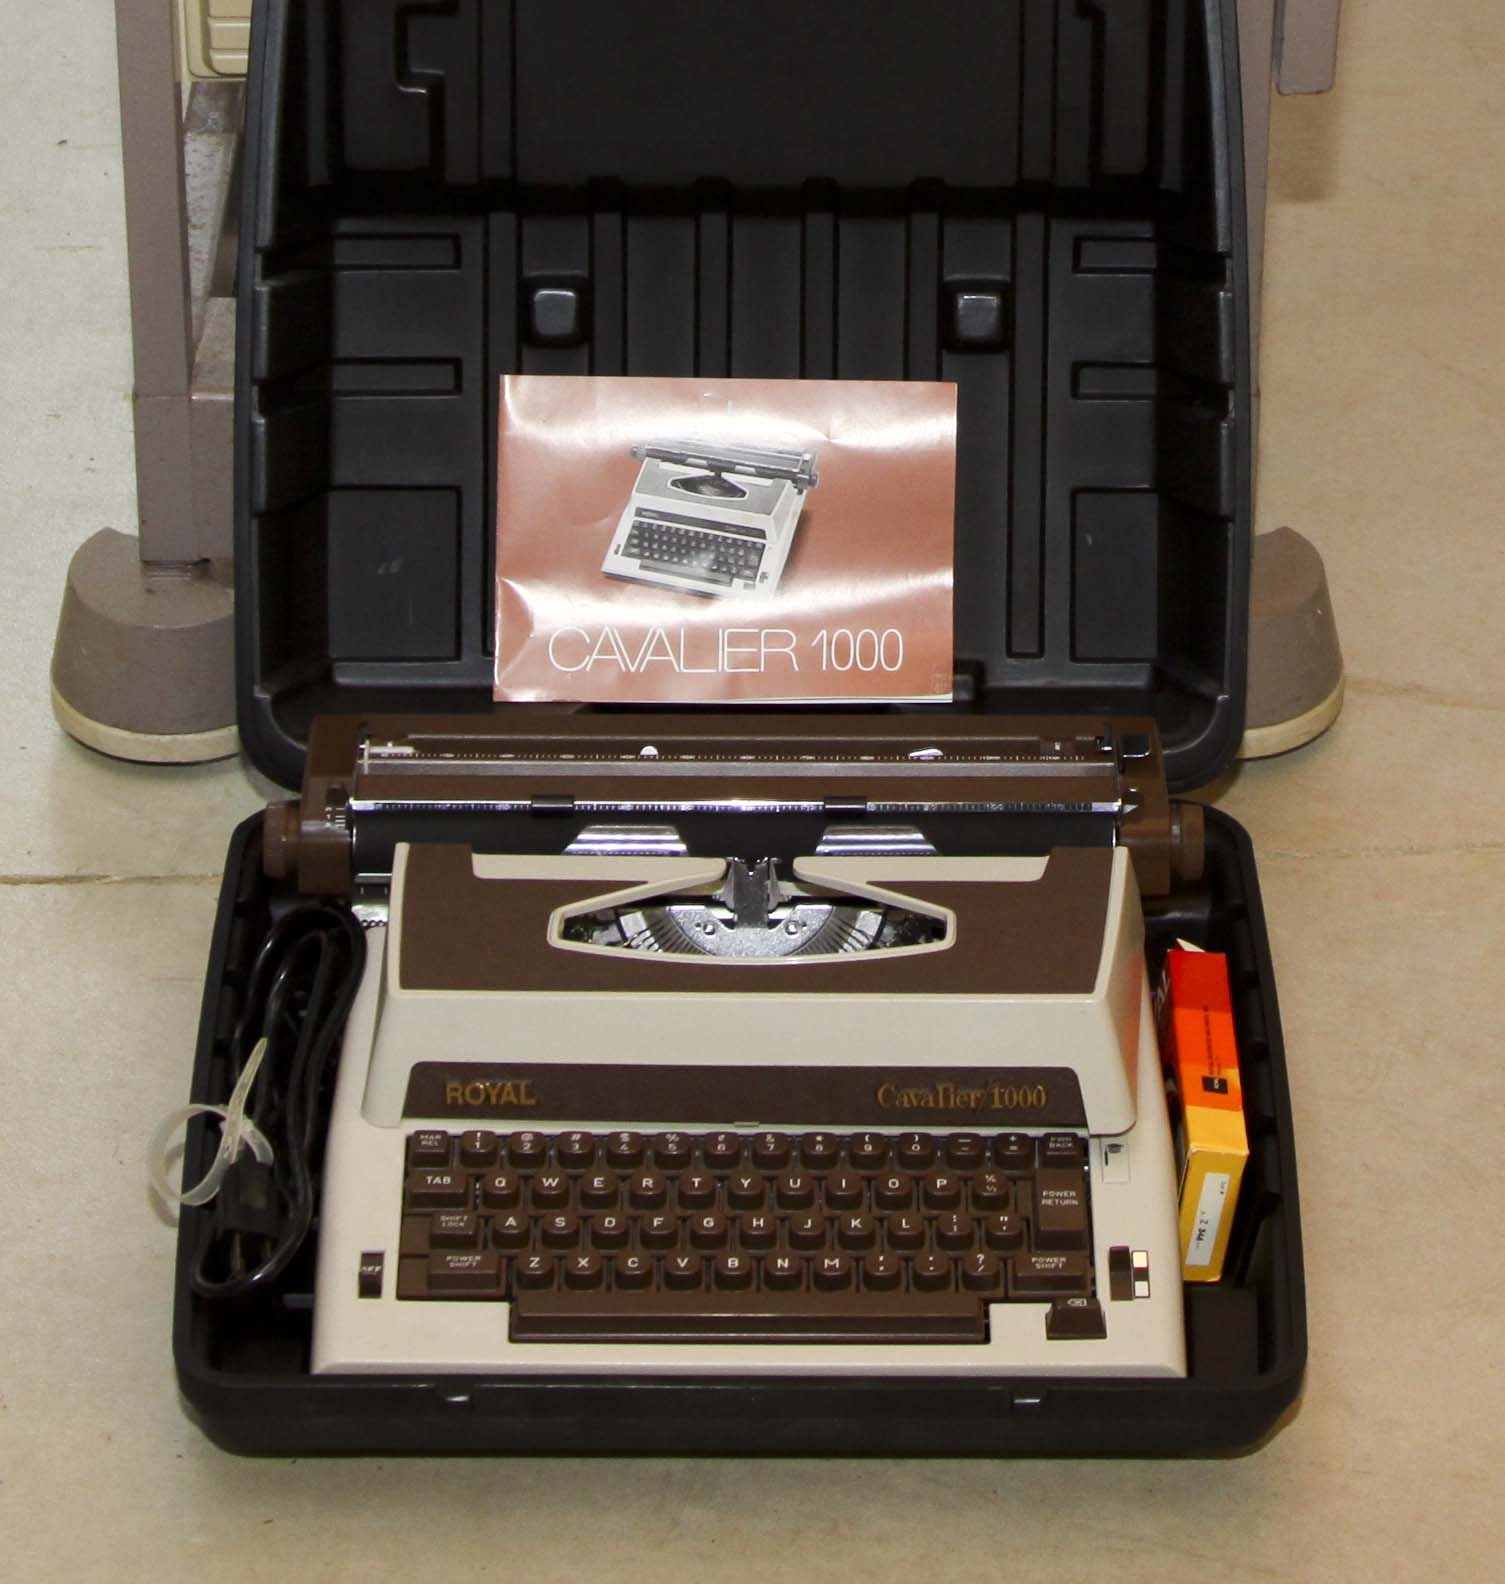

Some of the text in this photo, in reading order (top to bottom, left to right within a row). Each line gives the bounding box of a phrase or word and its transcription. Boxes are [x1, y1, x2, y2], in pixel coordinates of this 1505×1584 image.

[548, 624, 903, 672] CAVALIER 1000
[446, 1081, 537, 1105] ROYAL
[426, 1176, 452, 1184] TAB
[495, 1178, 505, 1187] Q
[543, 1178, 559, 1186] W
[594, 1178, 603, 1187] E
[643, 1178, 653, 1187] R
[692, 1178, 701, 1187] T
[741, 1179, 750, 1187] Y
[790, 1179, 800, 1187] U
[889, 1179, 899, 1188] O
[937, 1179, 947, 1188] P
[506, 1217, 911, 1228] A S D F G H J K L
[530, 1257, 539, 1267] Z
[578, 1258, 588, 1267] X
[628, 1258, 638, 1267] C
[678, 1258, 688, 1267] V
[728, 1258, 738, 1267] B
[778, 1259, 788, 1267] N
[825, 1259, 839, 1268] M
